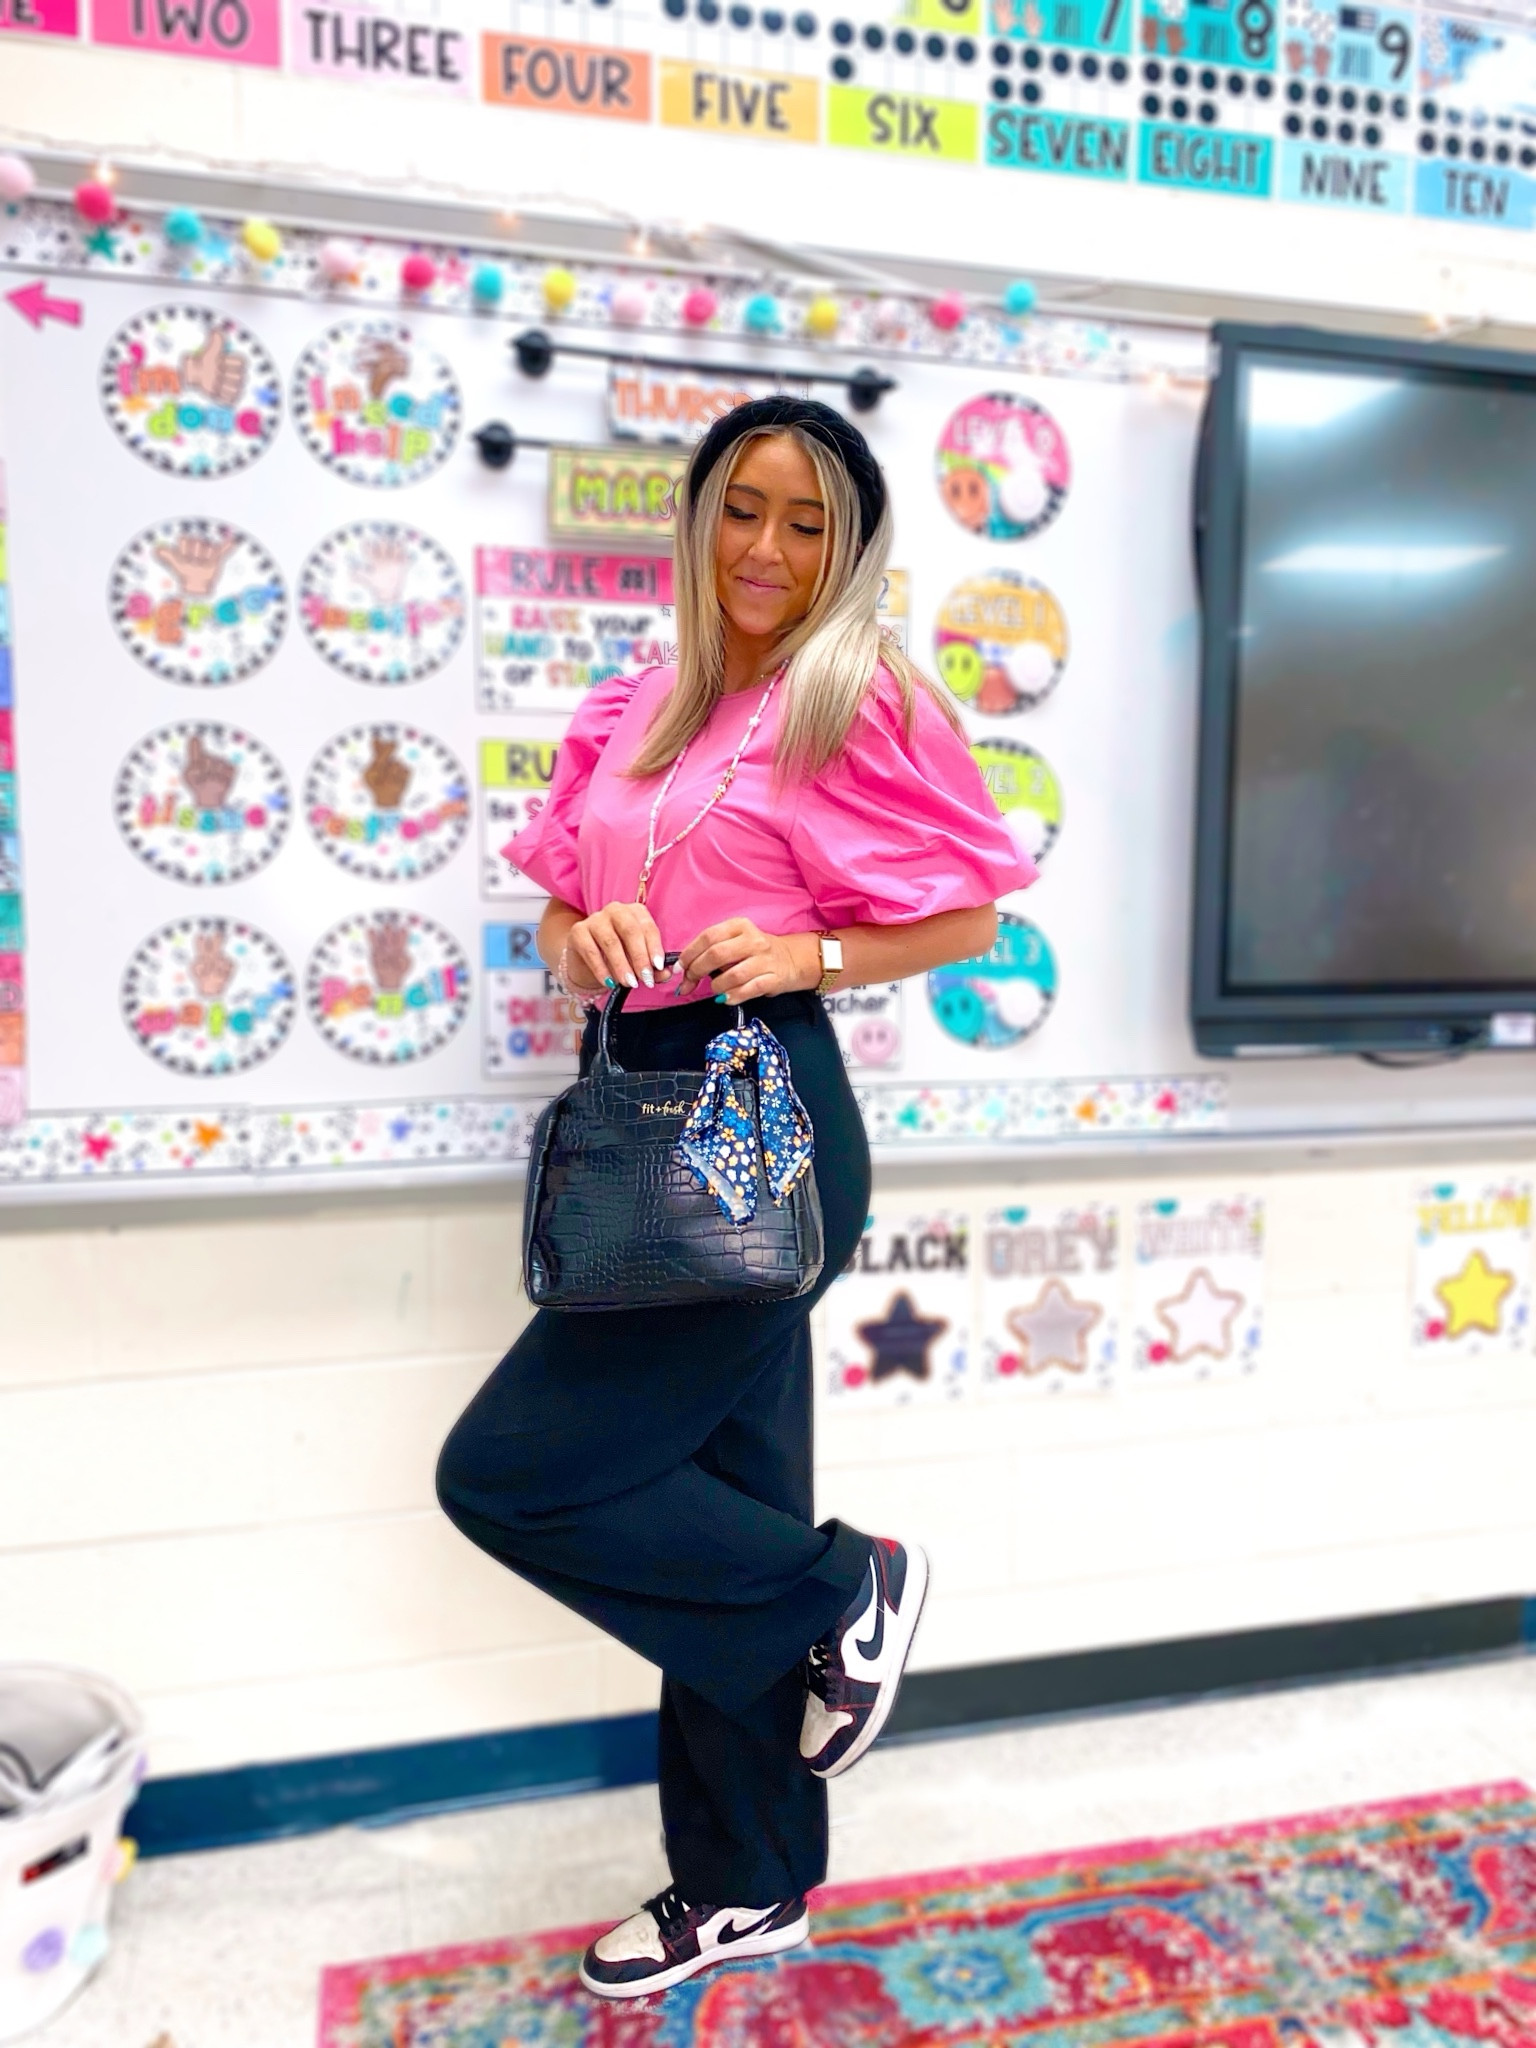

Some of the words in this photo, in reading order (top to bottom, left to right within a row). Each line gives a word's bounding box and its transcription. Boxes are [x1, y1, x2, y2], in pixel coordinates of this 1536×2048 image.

[303, 8, 462, 83] THREE
[1236, 0, 1274, 59] 8
[1379, 21, 1411, 82] 9
[502, 42, 633, 108] FOUR
[692, 71, 790, 131] FIVE
[866, 93, 941, 152] SIX
[988, 108, 1130, 173] SEVEN
[1153, 129, 1262, 186] EIGHT
[1301, 153, 1390, 205] NINE
[1444, 168, 1510, 217] TEN
[570, 469, 683, 522] MAR
[511, 552, 602, 597] RULE
[507, 744, 558, 783] RU
[821, 992, 891, 1014] acher
[846, 1232, 966, 1274] LACK
